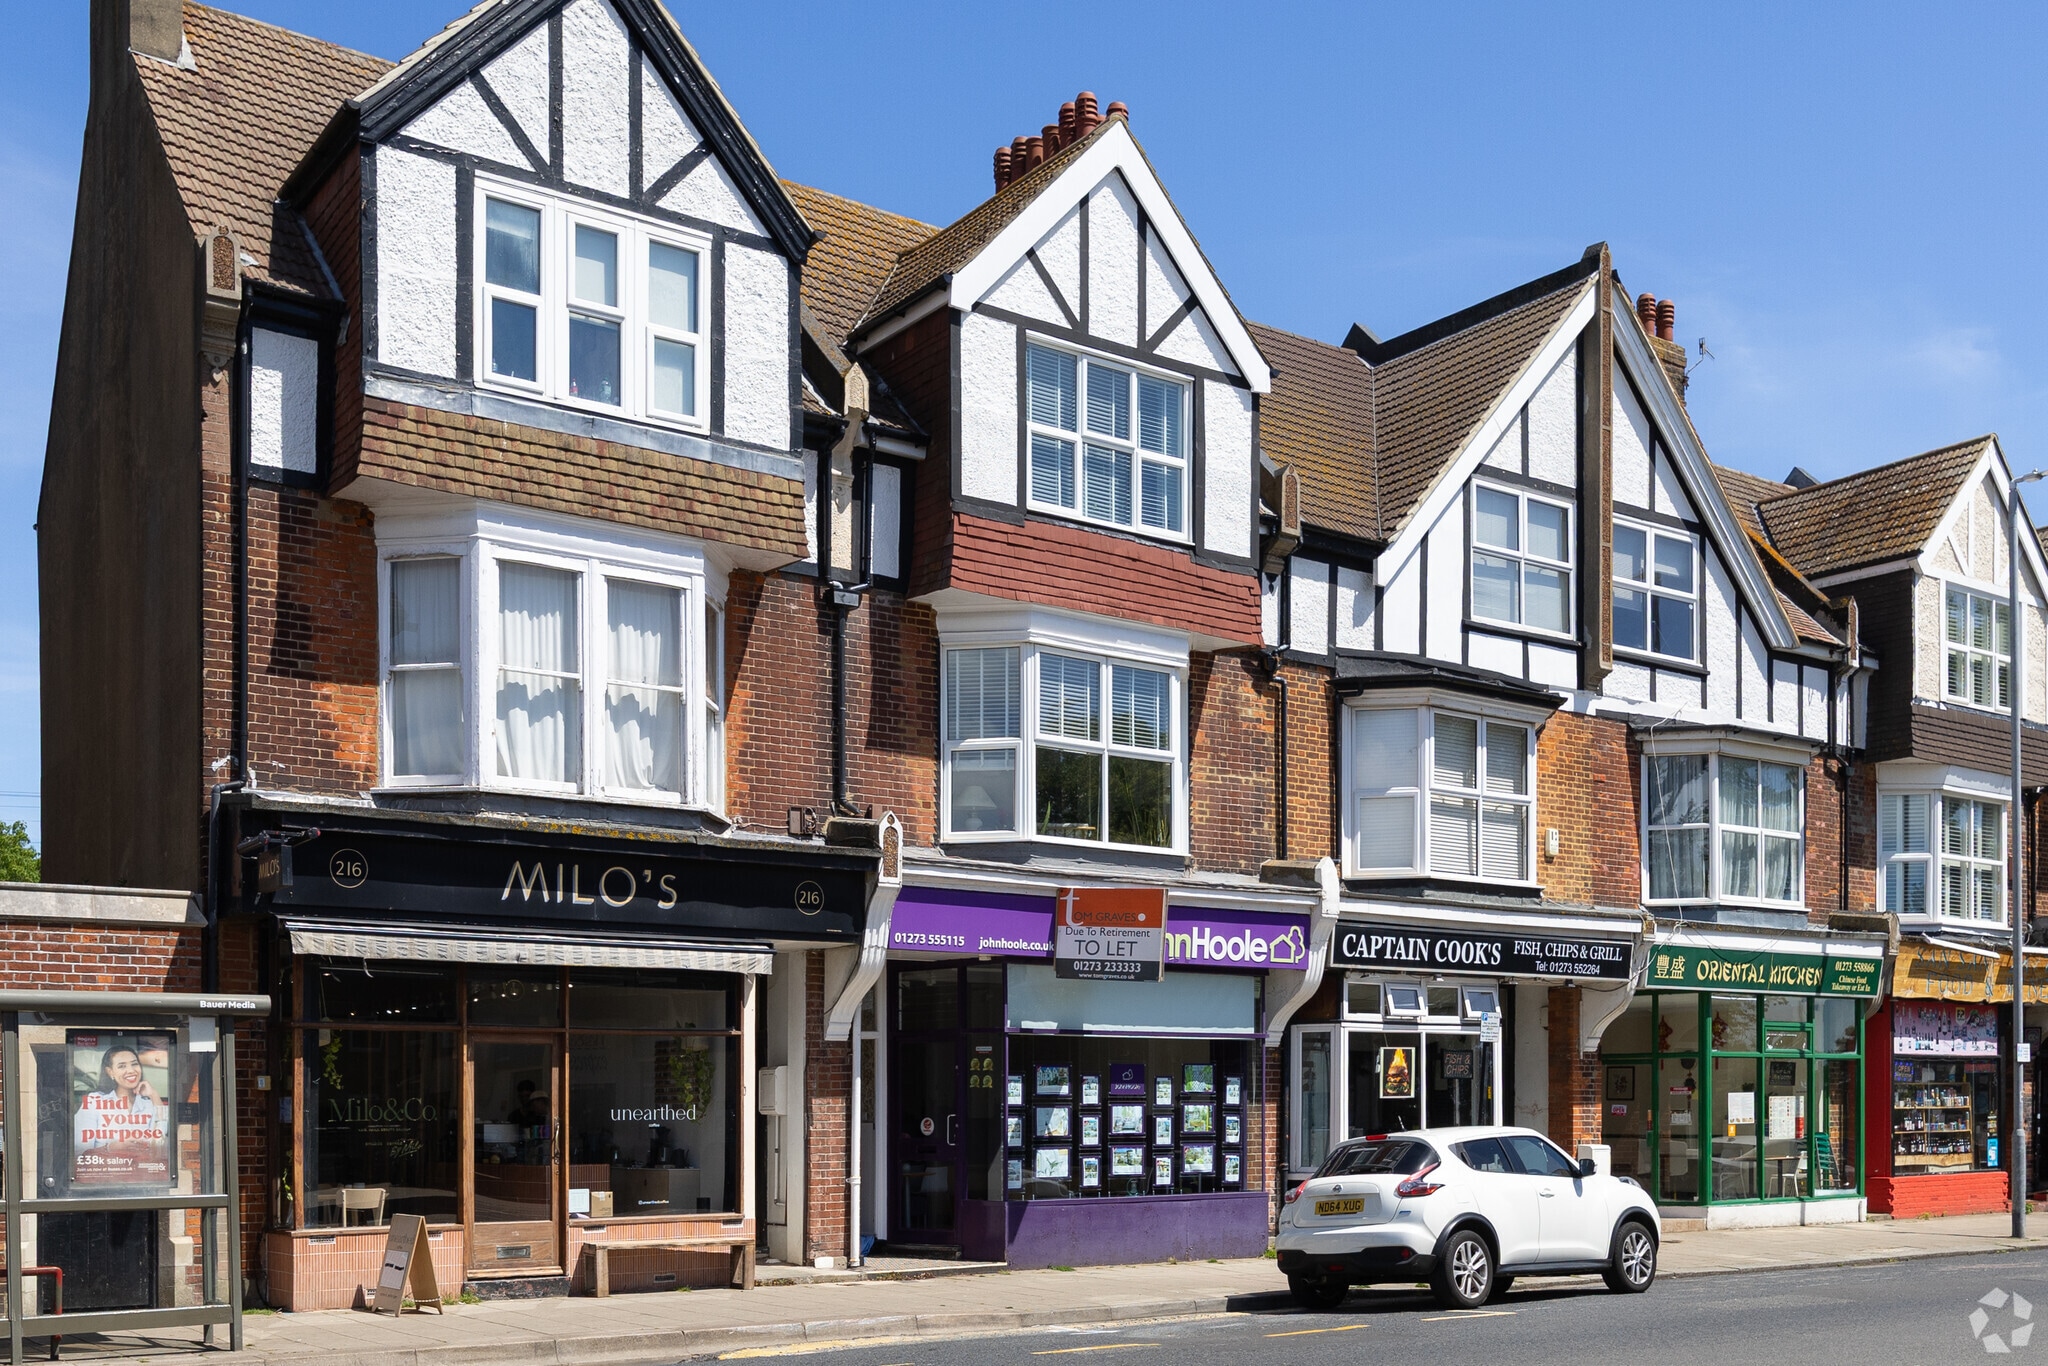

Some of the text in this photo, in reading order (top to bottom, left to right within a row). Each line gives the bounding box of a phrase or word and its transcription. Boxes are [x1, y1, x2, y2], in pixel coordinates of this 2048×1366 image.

[335, 860, 362, 877] 216
[501, 861, 678, 909] MILO'S
[800, 889, 820, 905] 216
[1095, 911, 1137, 922] GRAVES
[894, 932, 965, 947] 01273 555115
[1065, 926, 1151, 938] Due To Retirement
[977, 936, 1055, 952] johnhoole.co.uk
[1074, 940, 1138, 957] TO LET
[1342, 933, 1502, 966] CAPTAIN COOK'S
[1513, 940, 1623, 961] FISH, CHIPS & GRILL
[1073, 960, 1141, 973] 01273 233333
[1535, 960, 1600, 975] Tel: 01273 552264
[1696, 959, 1823, 987] ORIENTAL KITCHEN
[1834, 960, 1853, 972] 01273
[1926, 971, 1974, 996] FOOD
[199, 1000, 256, 1009] Bauer Media
[1444, 1053, 1471, 1065] FISH &
[1446, 1064, 1470, 1075] CHIPS
[82, 1095, 129, 1110] Find
[610, 1104, 697, 1121] unearthed
[101, 1113, 153, 1128] your
[81, 1128, 163, 1143] purpose
[76, 1156, 133, 1166] £38k salary
[1318, 1200, 1361, 1213] ND64 XUG
